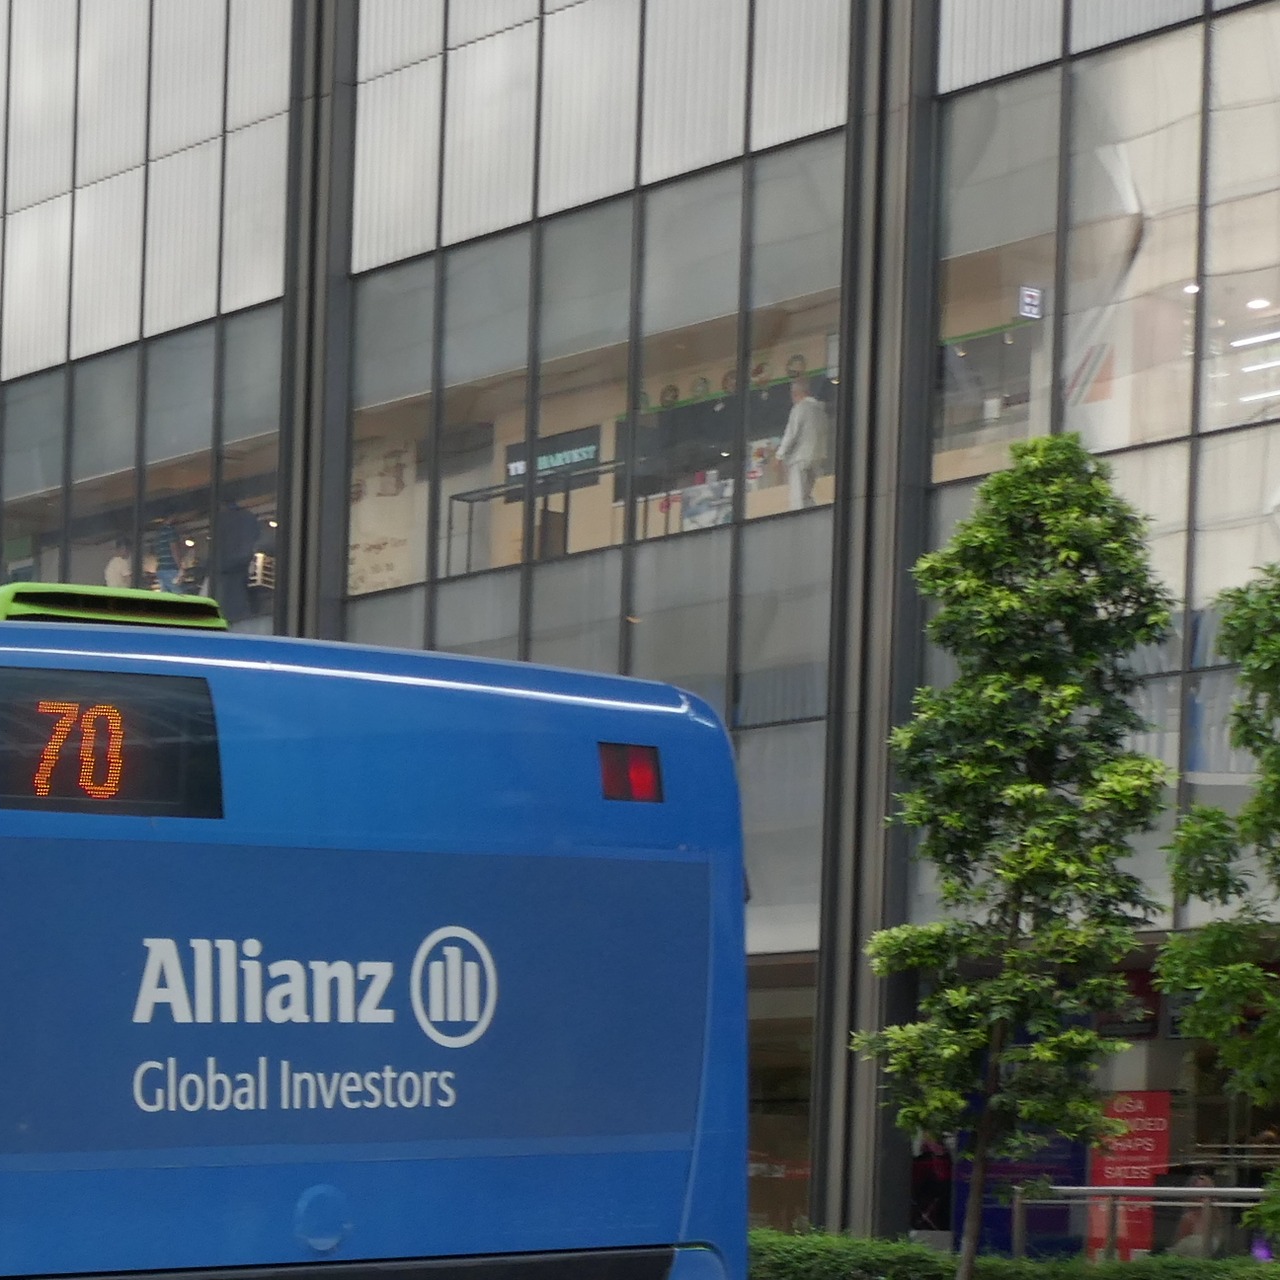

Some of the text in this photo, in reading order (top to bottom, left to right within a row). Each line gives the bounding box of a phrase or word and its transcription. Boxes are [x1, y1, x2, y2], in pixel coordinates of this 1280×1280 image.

[35, 701, 124, 799] 70
[132, 937, 395, 1024] Allianz
[133, 1056, 457, 1113] Global Investors
